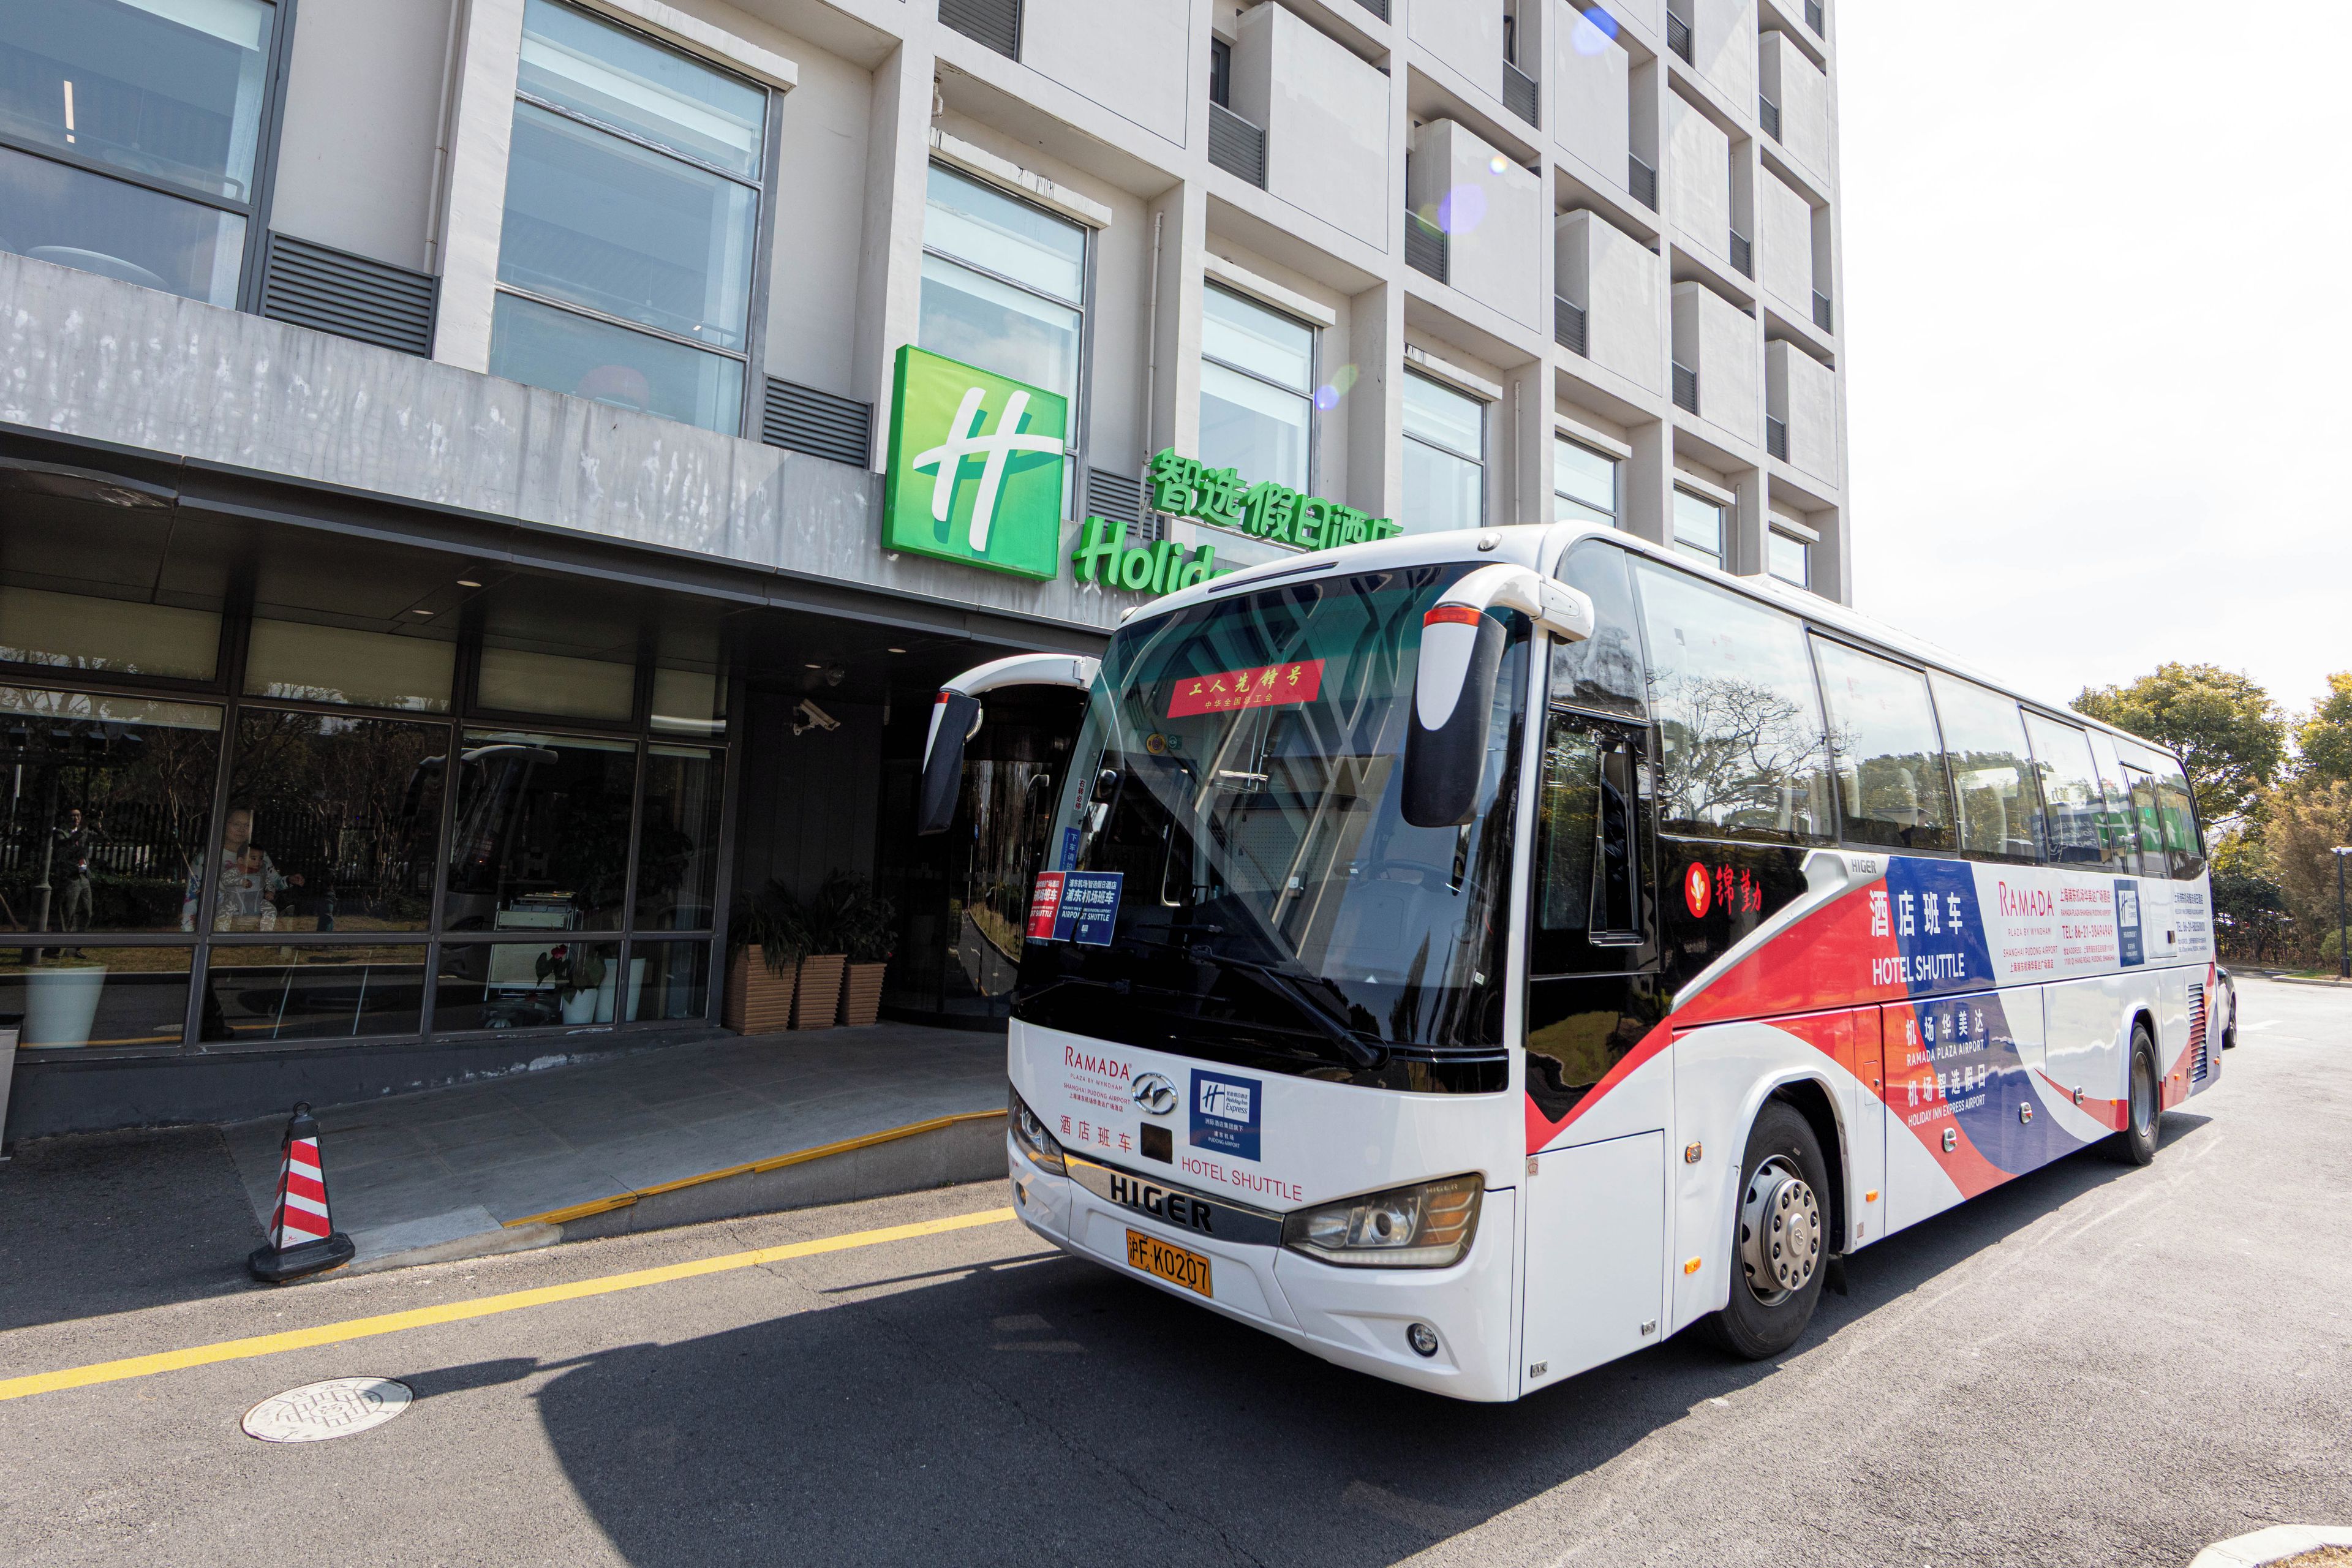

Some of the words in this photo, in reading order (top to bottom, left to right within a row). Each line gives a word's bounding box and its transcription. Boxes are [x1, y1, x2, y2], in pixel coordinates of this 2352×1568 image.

[1072, 516, 1235, 596] Holid
[1189, 666, 1302, 696] 工人先锋号
[1205, 693, 1273, 709] 中华全国总工会
[1851, 859, 1877, 874] HIGER
[1065, 889, 1115, 905] 浦东机场班车
[1069, 879, 1117, 889] 浦东机场智选假日酒店
[1999, 881, 2054, 916] RAMADA
[1869, 889, 1962, 937] 酒店班车
[2008, 928, 2022, 937] PLAZA
[2030, 927, 2051, 936] WYNDHAM
[2062, 925, 2073, 940] TEL:
[2003, 948, 2024, 958] SHANGHAI
[2025, 947, 2041, 956] PUDONG
[2042, 945, 2057, 954] AIRPORT
[1872, 956, 1914, 986] HOTEL
[1915, 953, 1965, 981] SHUTTLE
[1905, 1009, 1984, 1046] 机场华美达
[1065, 1046, 1129, 1081] RAMADA
[1907, 1049, 1936, 1067] RAMADA
[1937, 1044, 1957, 1060] PLAZA
[1959, 1039, 1985, 1055] AIRPORT
[1063, 1083, 1086, 1093] SHANGHAI
[1087, 1089, 1107, 1099] PUDONG
[1109, 1095, 1130, 1105] AIRPORT
[1070, 1073, 1085, 1082] PLAZA
[1096, 1079, 1123, 1091] WYNDHAM
[1907, 1064, 1986, 1108] 机场智选假日
[1226, 1096, 1241, 1105] Holiday
[1226, 1104, 1248, 1114] Express
[1908, 1109, 1932, 1127] HOLIDAY
[1932, 1107, 1942, 1120] INN
[1943, 1100, 1965, 1117] EXPRESS
[1965, 1094, 1986, 1110] AIRPORT
[1060, 1115, 1133, 1153] 酒店班车
[1208, 1136, 1224, 1145] PUDONG
[1224, 1140, 1240, 1148] AIRPORT
[1182, 1156, 1227, 1183] HOTEL
[1232, 1170, 1303, 1202] SHUTTLE
[1110, 1174, 1213, 1234] HIGER
